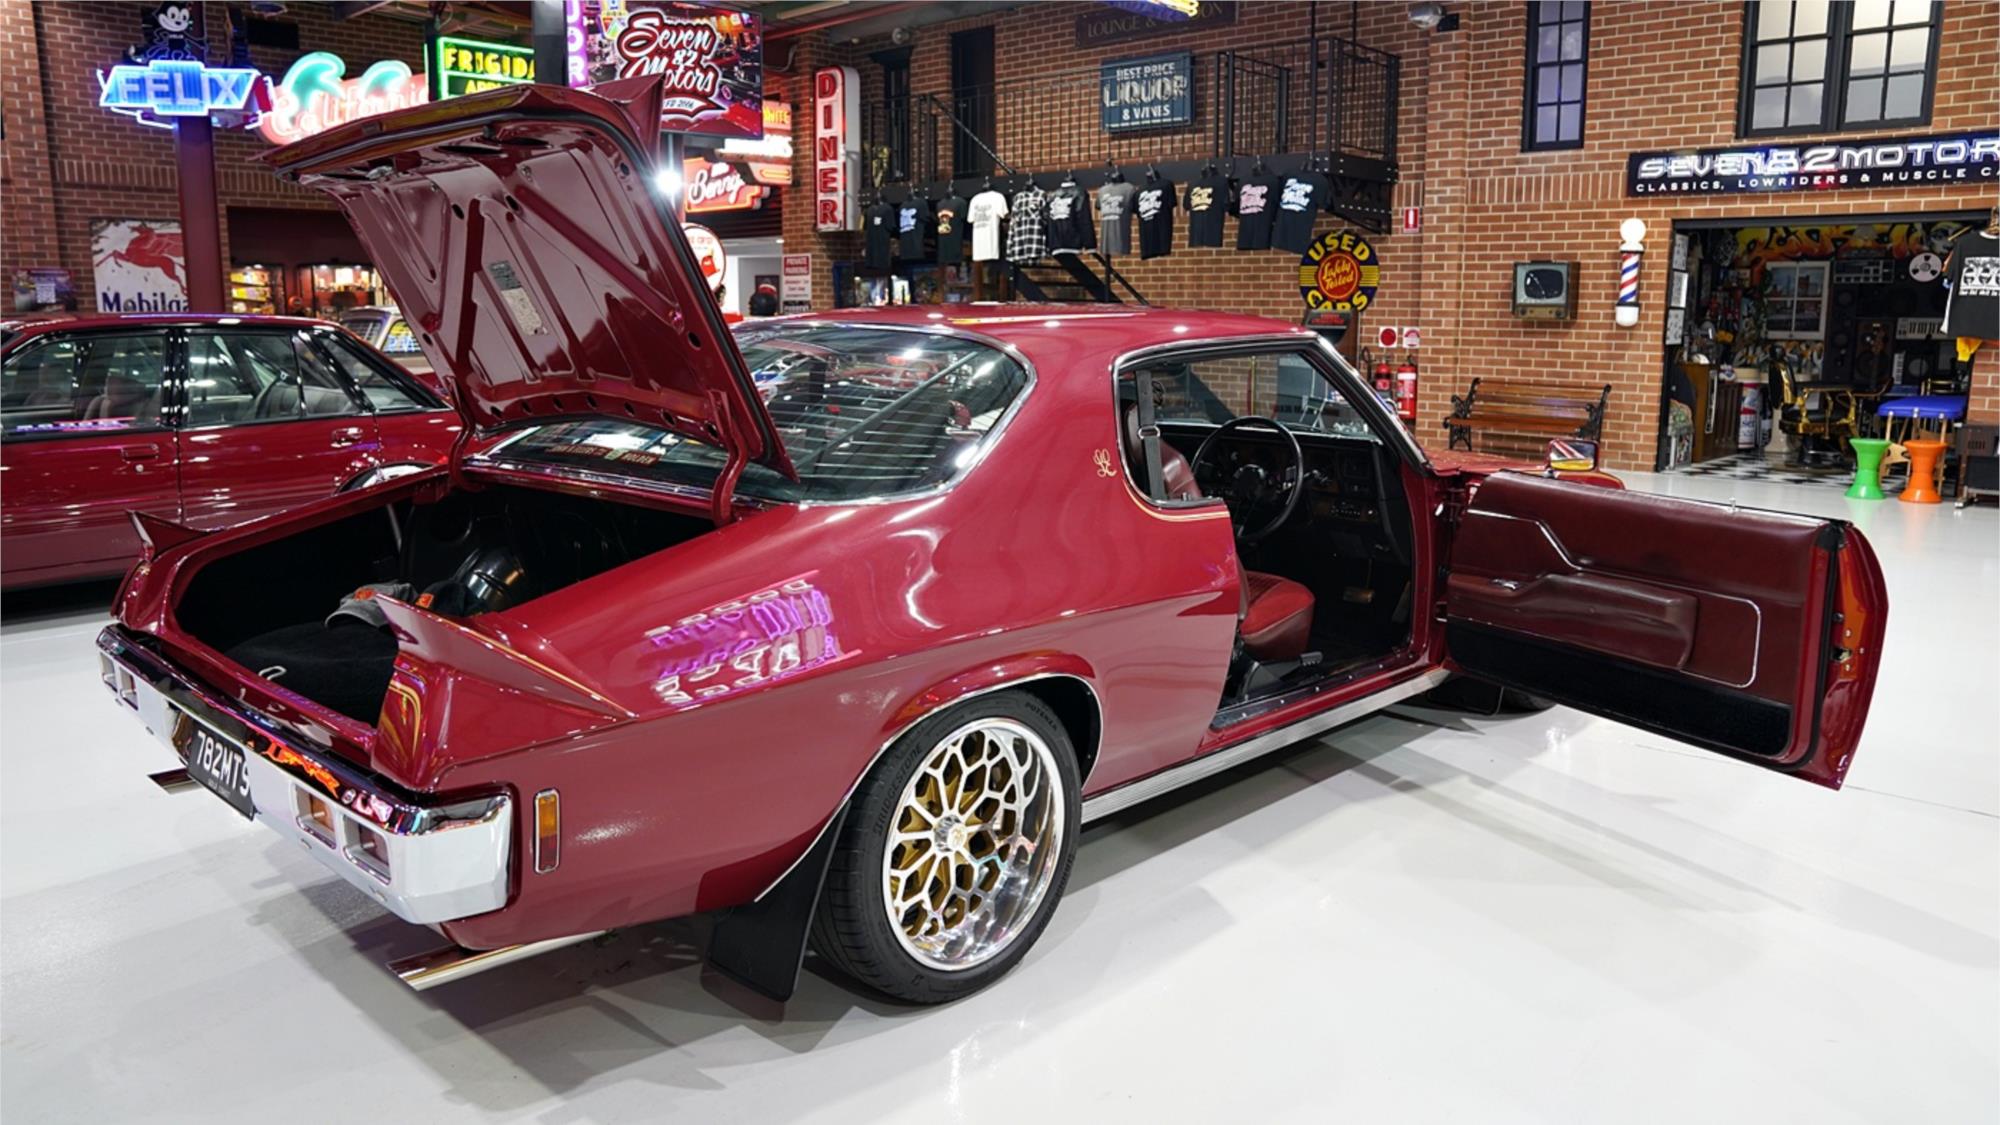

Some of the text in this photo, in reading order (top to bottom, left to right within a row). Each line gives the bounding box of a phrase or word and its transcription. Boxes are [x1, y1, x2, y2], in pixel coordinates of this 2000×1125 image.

[621, 17, 712, 57] Seven
[1087, 16, 1141, 37] LOUNGE
[672, 50, 698, 67] 82
[1116, 62, 1176, 81] BEST PRICE
[117, 71, 239, 106] FELIX
[625, 57, 714, 93] Motors
[1103, 75, 1187, 107] LIQUOR
[1122, 108, 1130, 120] &
[818, 73, 838, 224] DINER
[1636, 180, 1725, 193] CLASSICS,
[1738, 174, 1848, 188] LOWRIDERS
[1860, 173, 1870, 183] &
[1882, 168, 1967, 182] MUSCLE
[1308, 233, 1370, 261] USED
[1307, 289, 1368, 312] CARS
[197, 730, 250, 797] 782MTS
[873, 743, 922, 836] BRIDGESTONE
